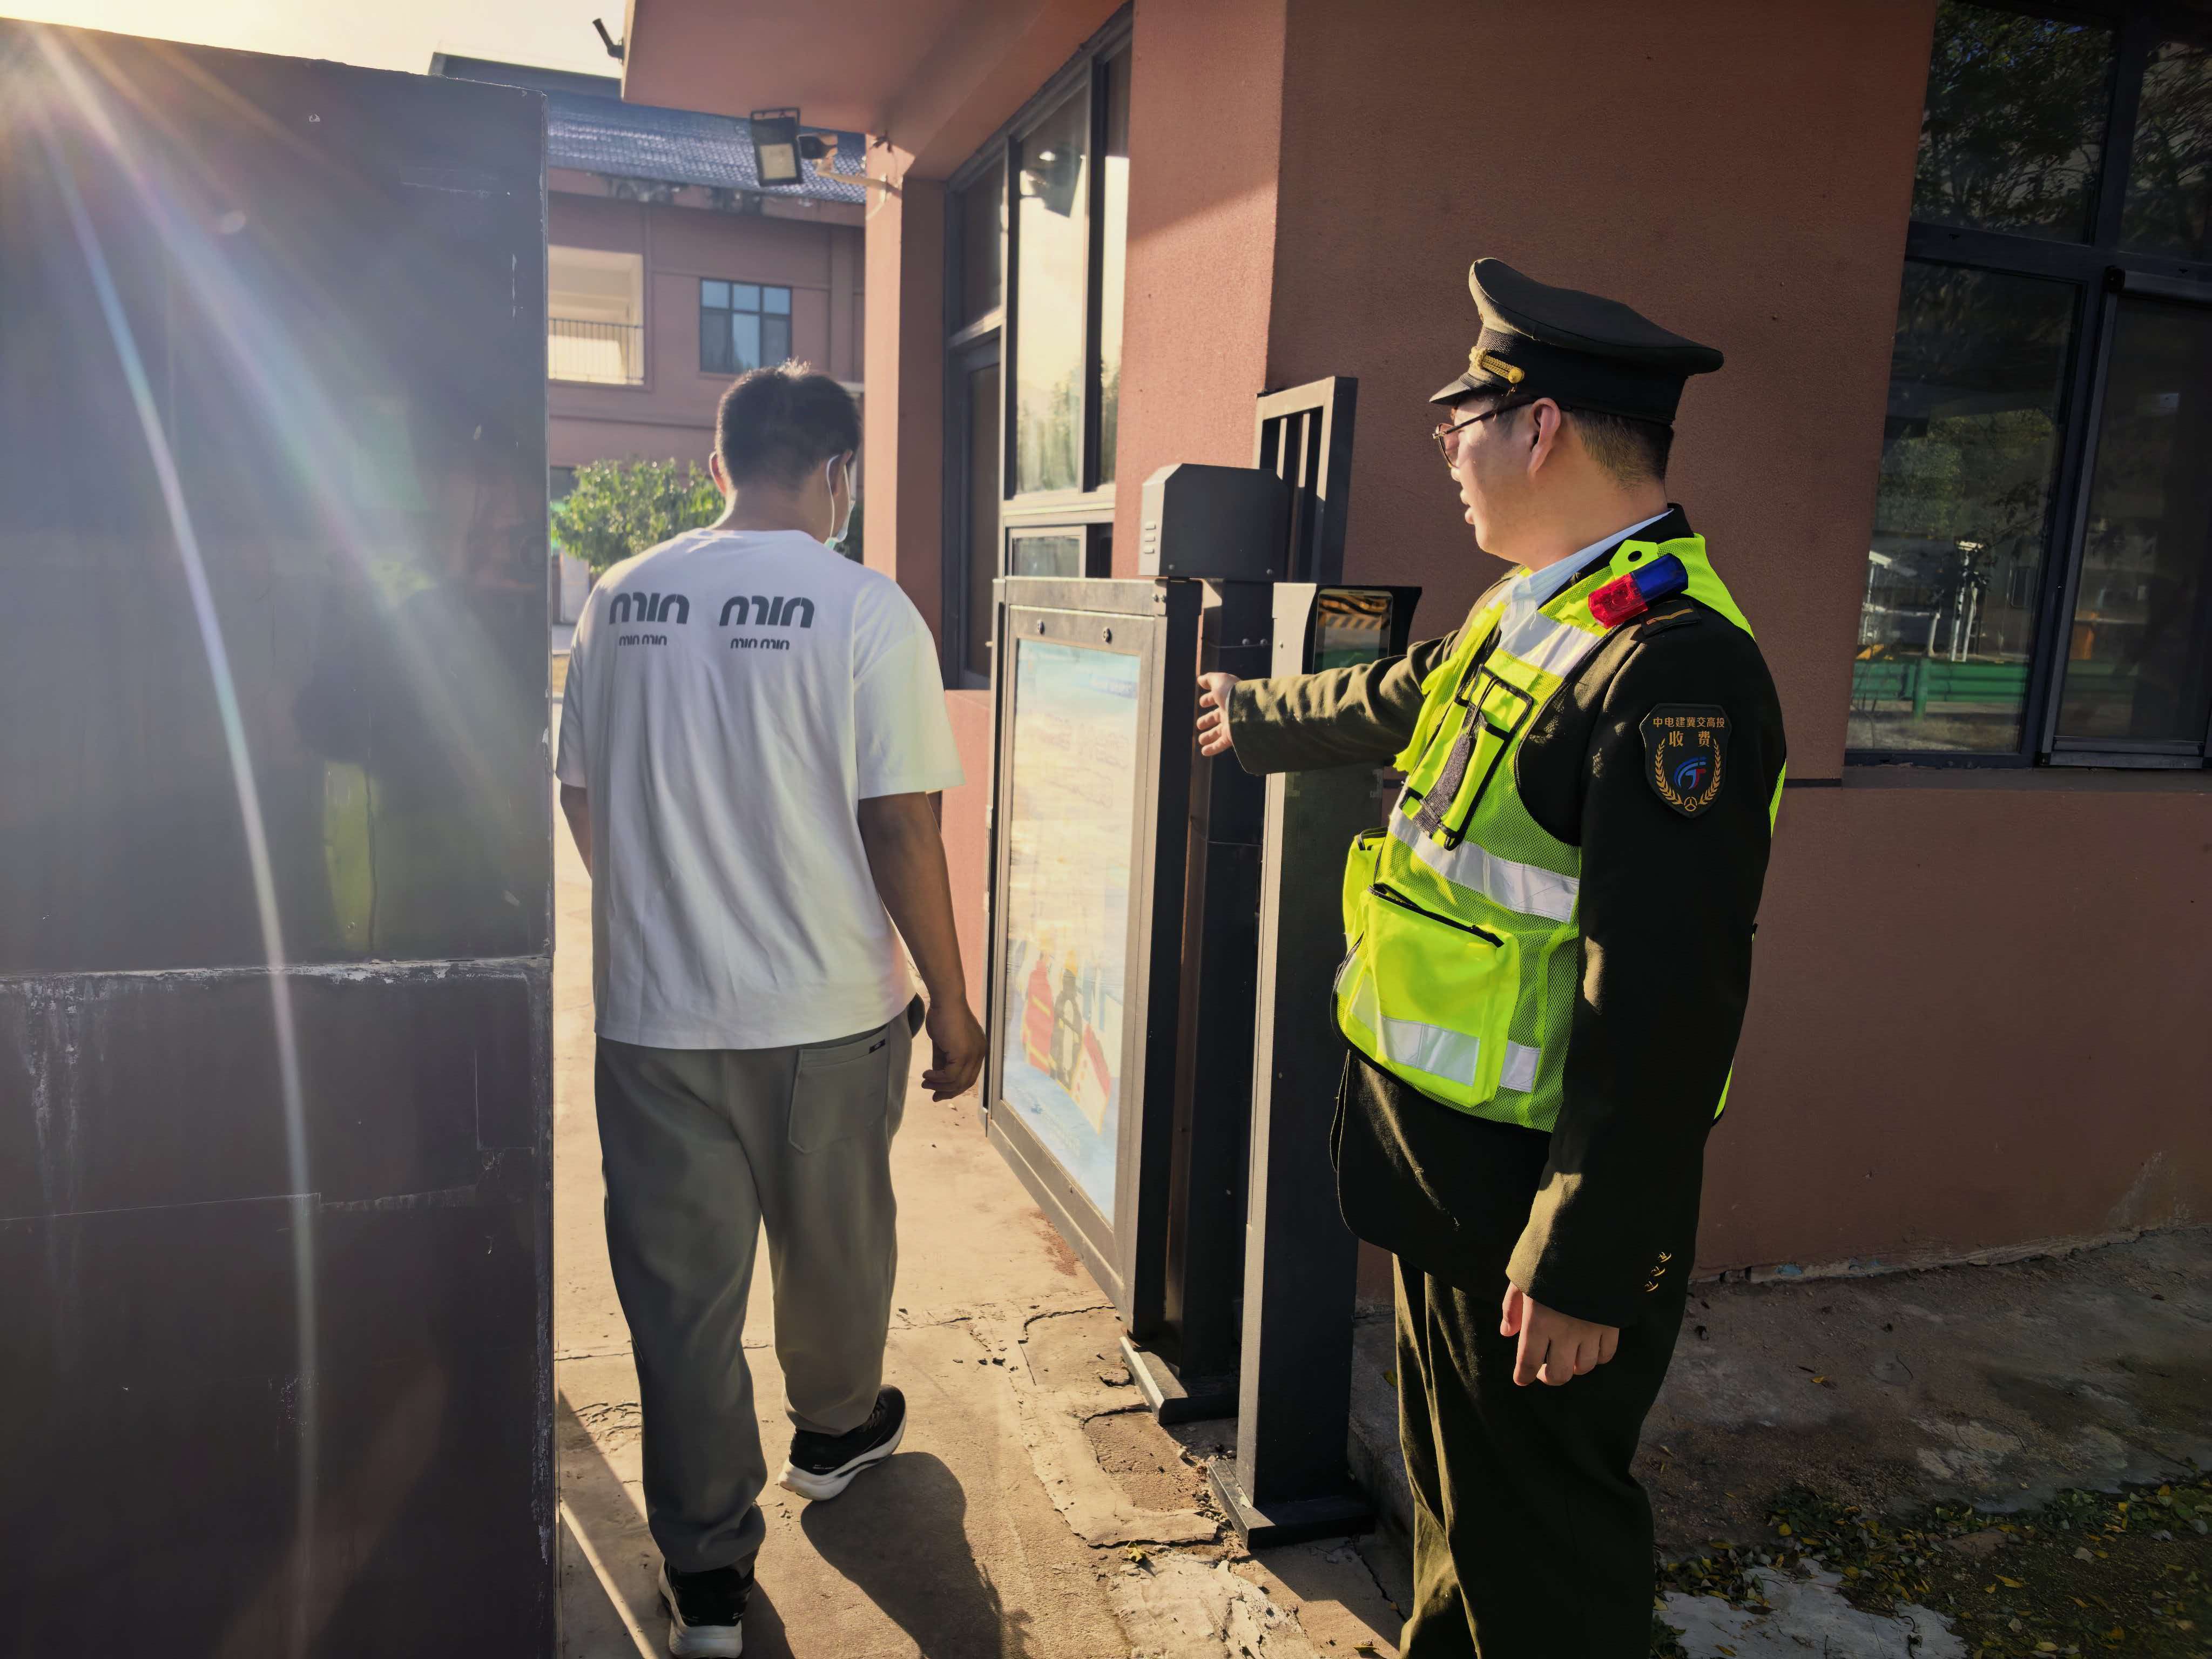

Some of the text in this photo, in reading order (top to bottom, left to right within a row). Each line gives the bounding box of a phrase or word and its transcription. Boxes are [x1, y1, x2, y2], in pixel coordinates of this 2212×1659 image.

[1653, 717, 1724, 728] 中电建冀交高投
